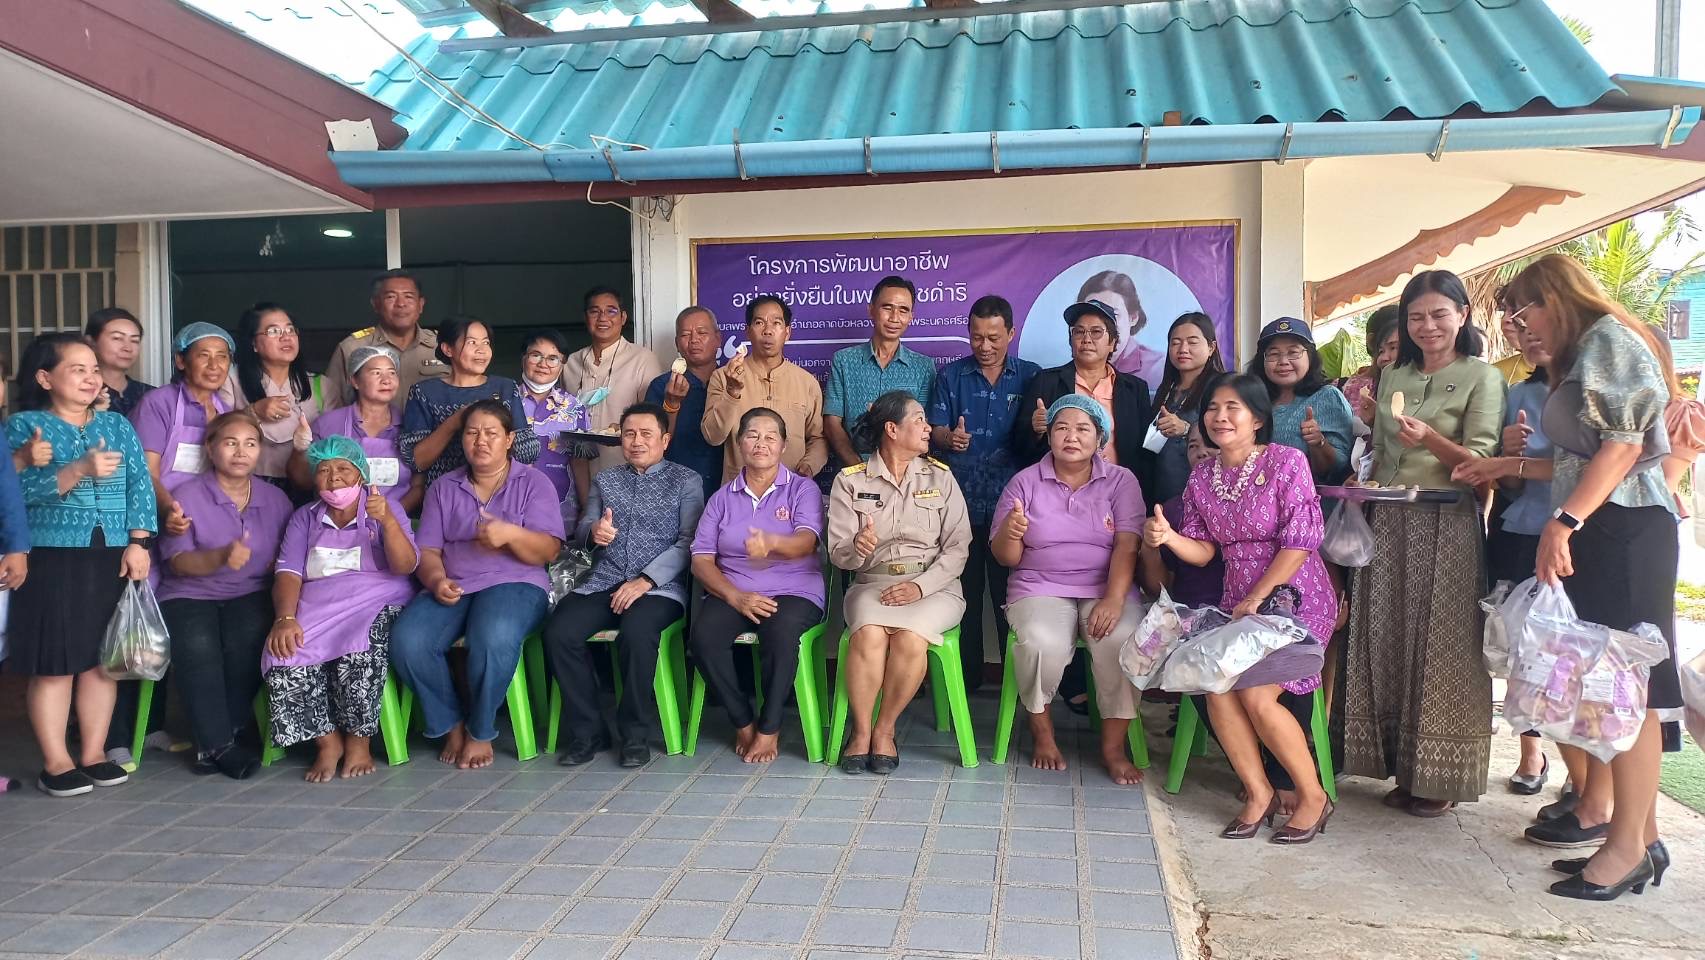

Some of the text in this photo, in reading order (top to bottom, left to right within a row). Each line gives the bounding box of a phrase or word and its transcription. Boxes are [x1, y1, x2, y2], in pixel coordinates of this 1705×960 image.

[748, 249, 950, 276] โครงการพัฒนาอาชีพ
